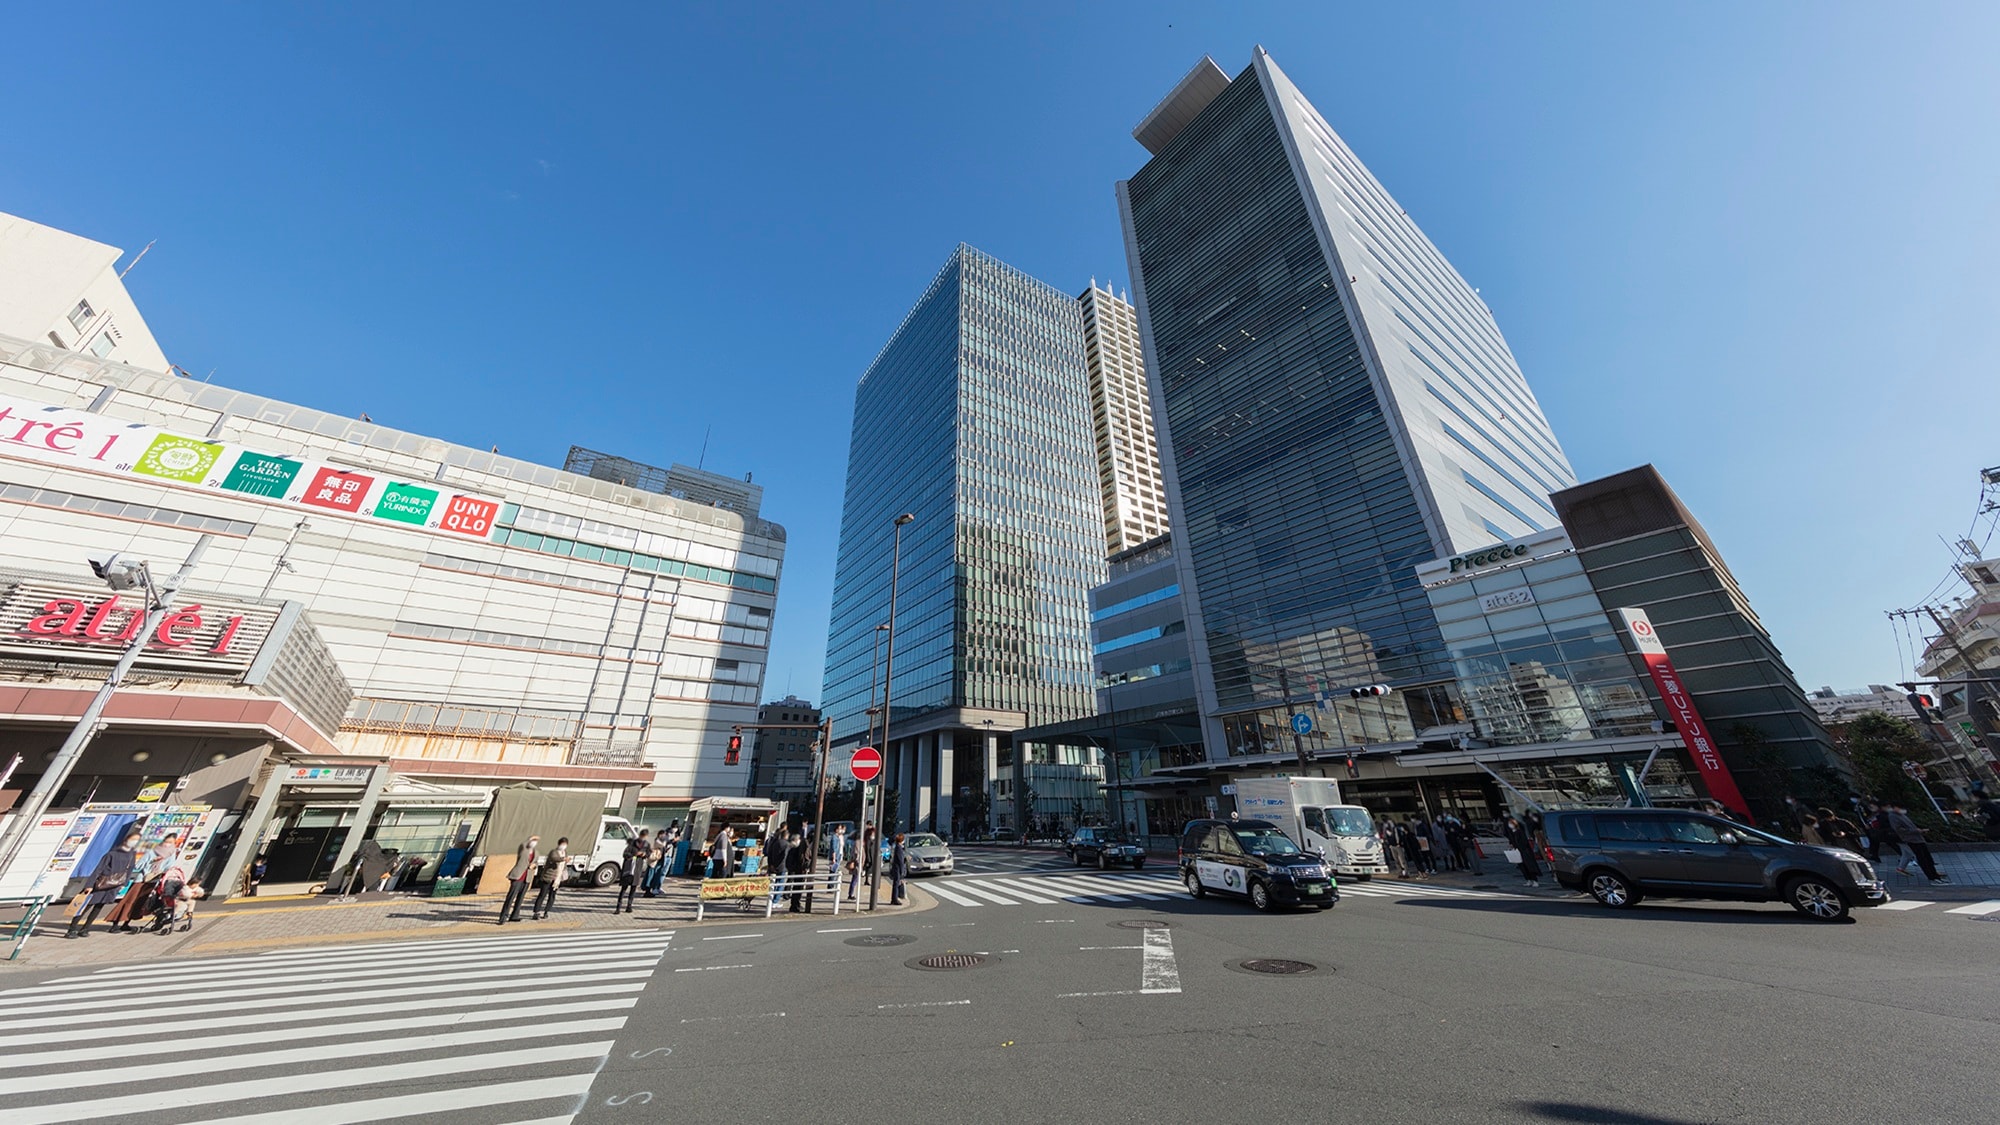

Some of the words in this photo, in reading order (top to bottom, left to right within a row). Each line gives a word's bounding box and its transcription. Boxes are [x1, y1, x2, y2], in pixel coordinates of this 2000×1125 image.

[89, 434, 120, 462] 1
[239, 463, 291, 480] GARDEN
[257, 459, 283, 471] THE
[323, 475, 361, 493] 無印
[315, 488, 352, 505] 良品
[382, 501, 427, 517] YURINDO
[452, 499, 490, 518] UNI
[446, 514, 487, 532] QLO
[1448, 543, 1527, 574] Precce
[208, 615, 243, 655] 1
[1655, 663, 1720, 771] 三菱UFJ銀行
[1223, 868, 1241, 889] GO
